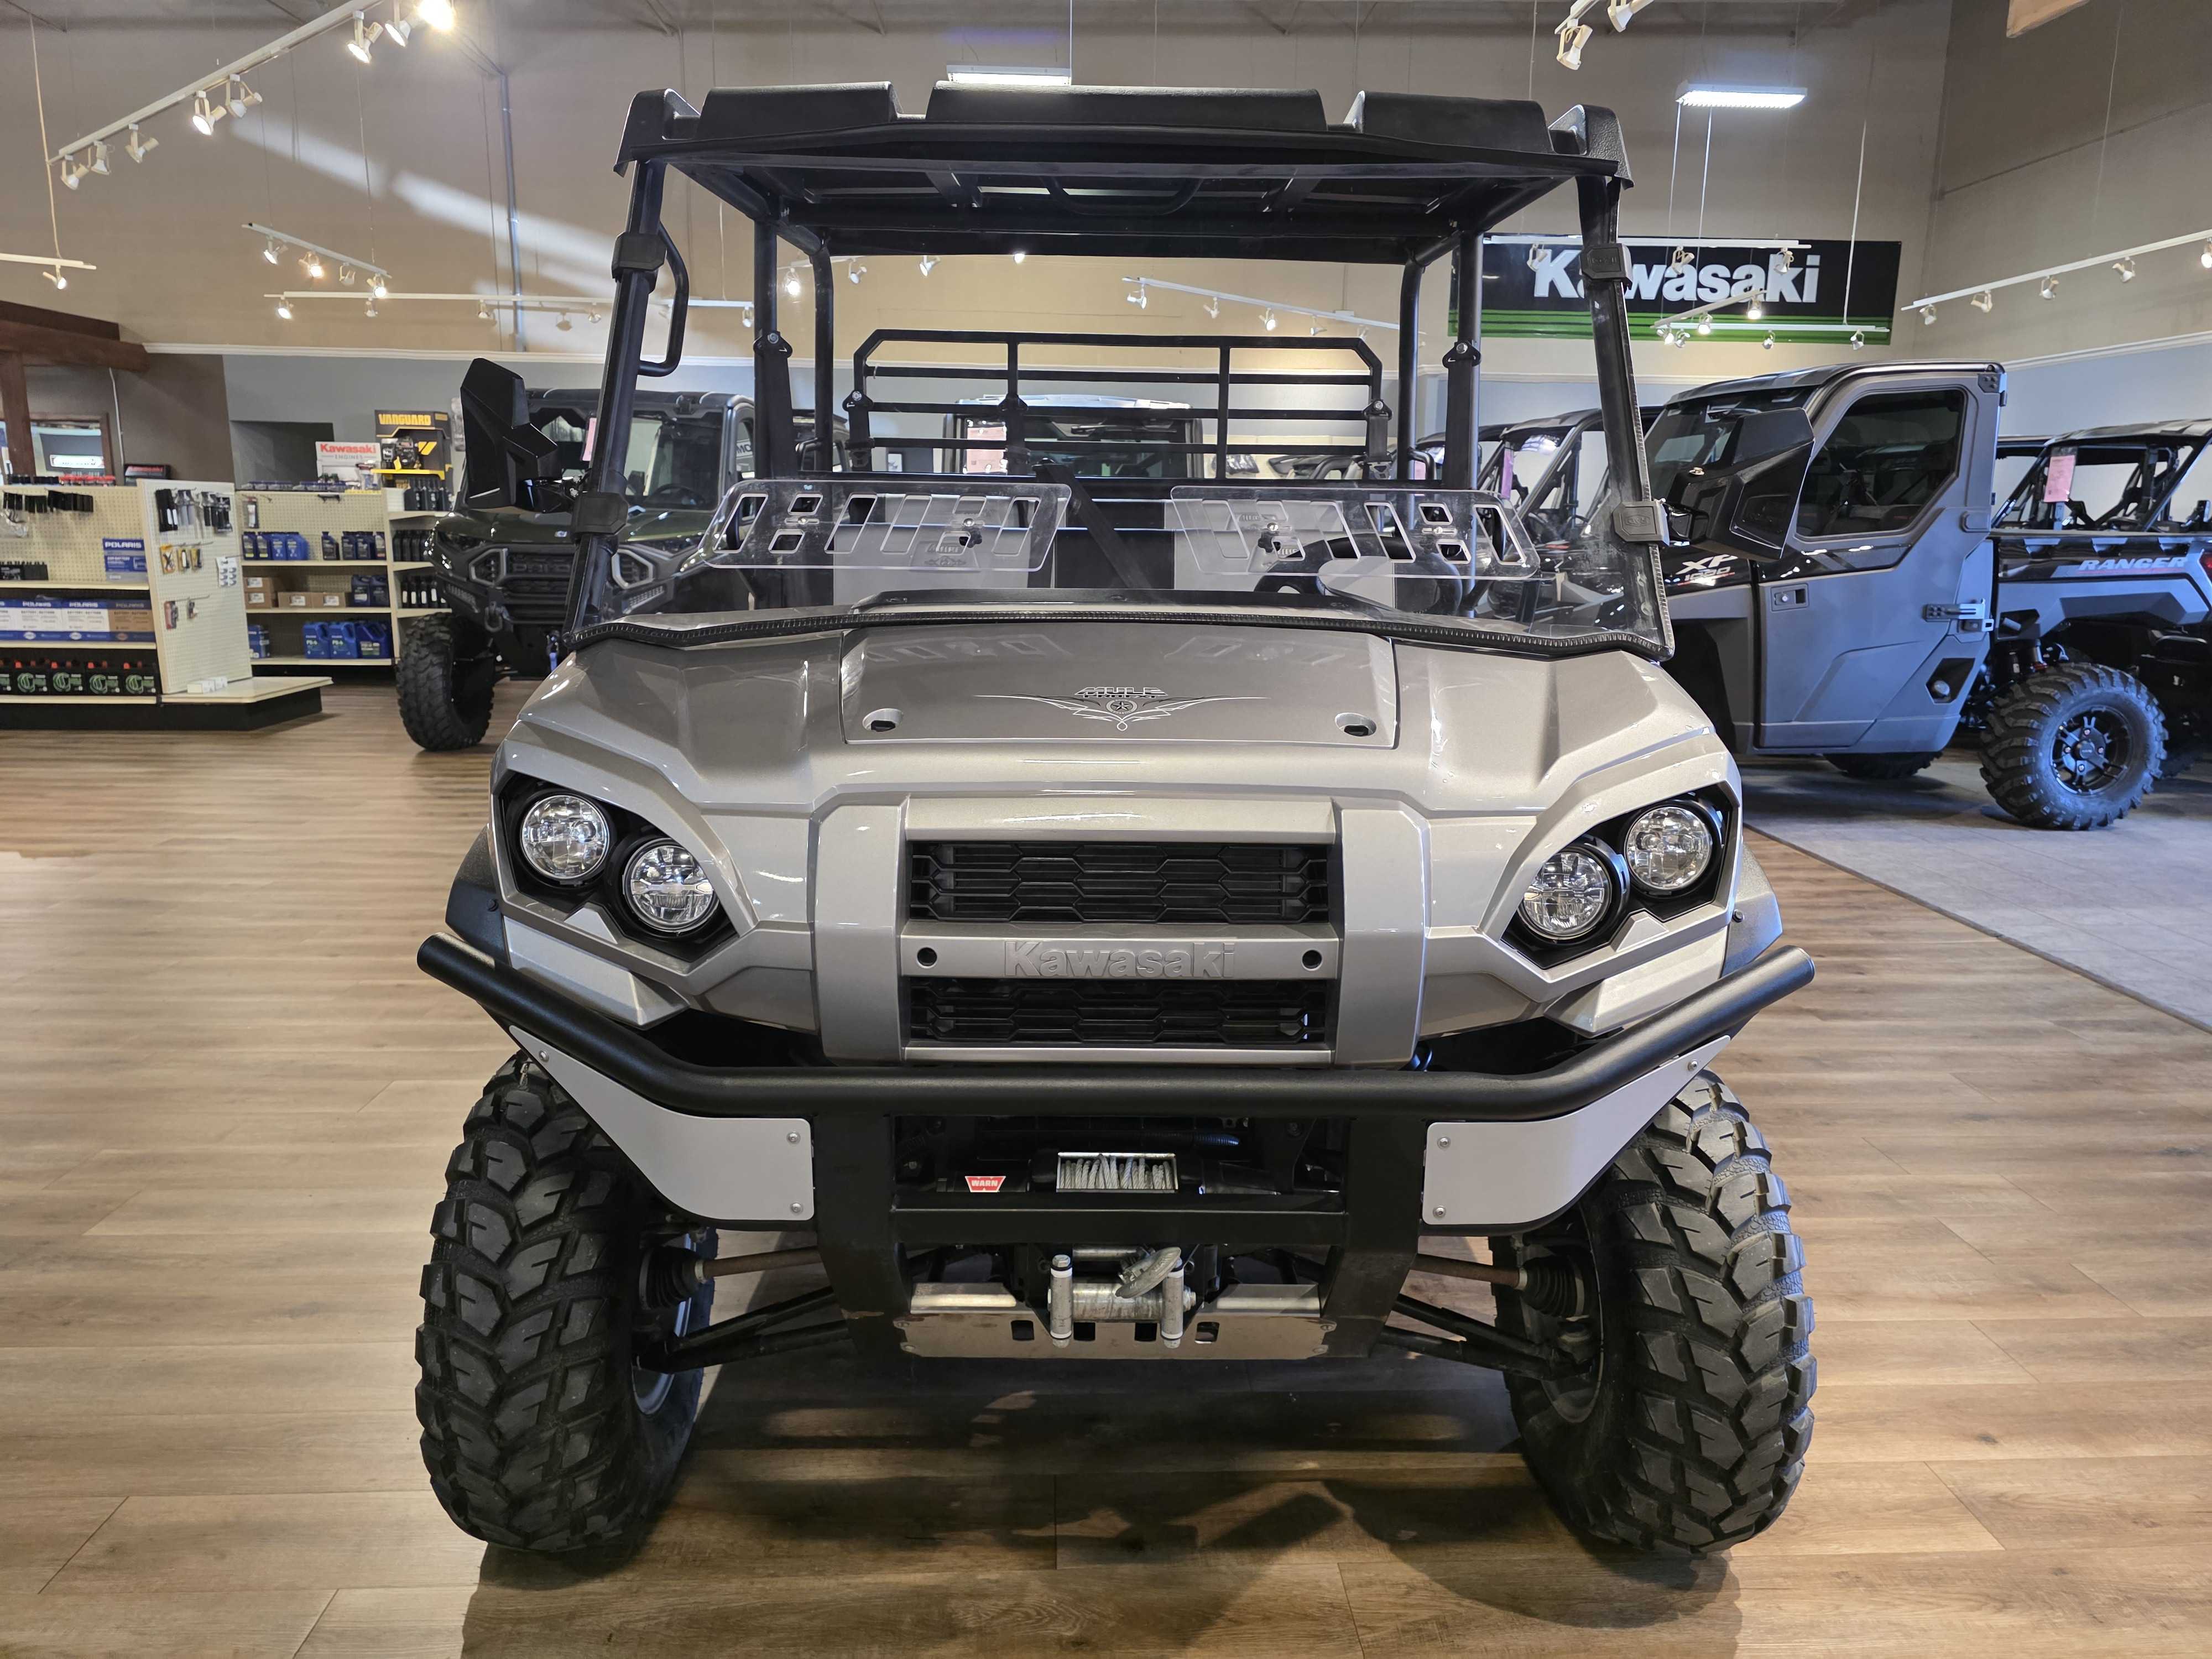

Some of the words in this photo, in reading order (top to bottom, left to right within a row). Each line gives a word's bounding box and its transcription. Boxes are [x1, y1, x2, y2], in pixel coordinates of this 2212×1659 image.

[1534, 248, 1820, 303] Kwasaki
[378, 414, 431, 425] VANGUARD
[320, 444, 377, 454] Kawasaki
[1676, 554, 1738, 575] XP
[2079, 557, 2188, 570] RANGER
[1075, 687, 1168, 696] MULE
[1004, 941, 1236, 978] Kawasaki
